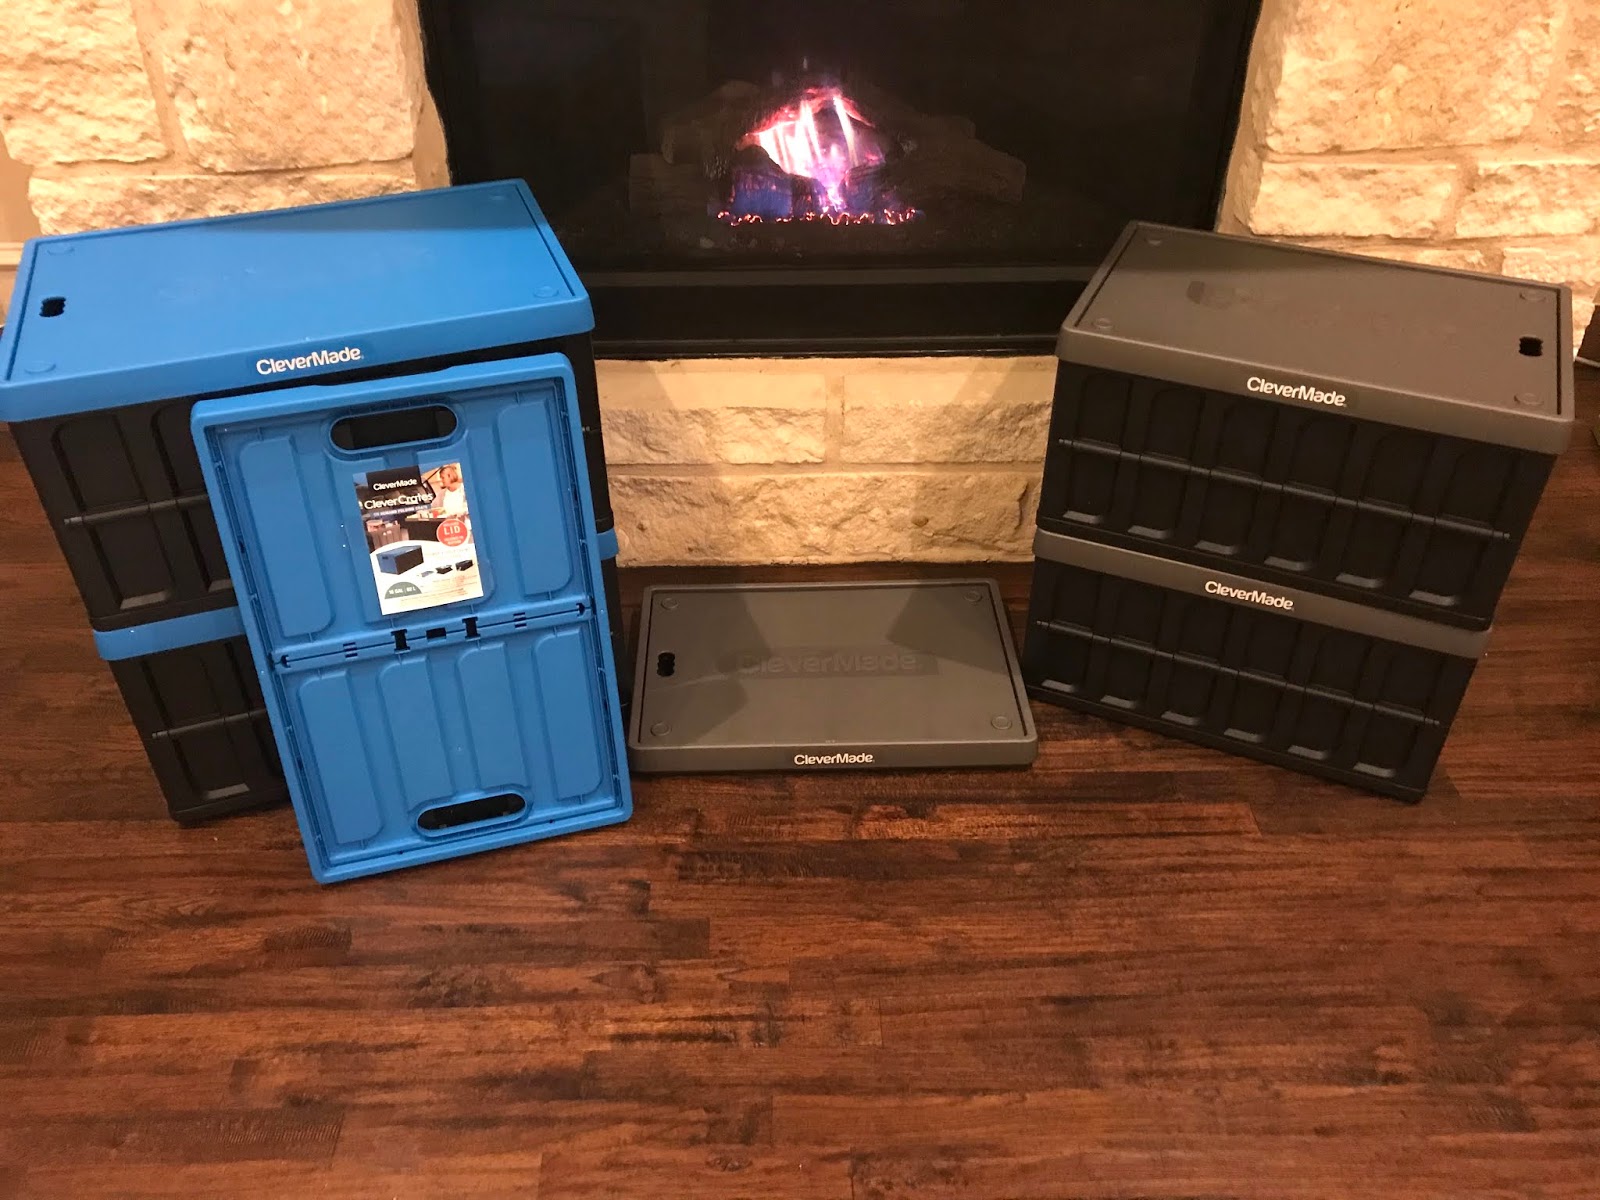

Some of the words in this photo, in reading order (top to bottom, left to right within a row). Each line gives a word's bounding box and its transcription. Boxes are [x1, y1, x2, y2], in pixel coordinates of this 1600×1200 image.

[256, 347, 361, 375] CleverMade
[1246, 376, 1346, 407] CleverMade
[373, 478, 418, 491] CleverMade
[443, 525, 461, 535] LID
[1205, 581, 1294, 610] CleverMade
[794, 752, 874, 765] CleverMade
